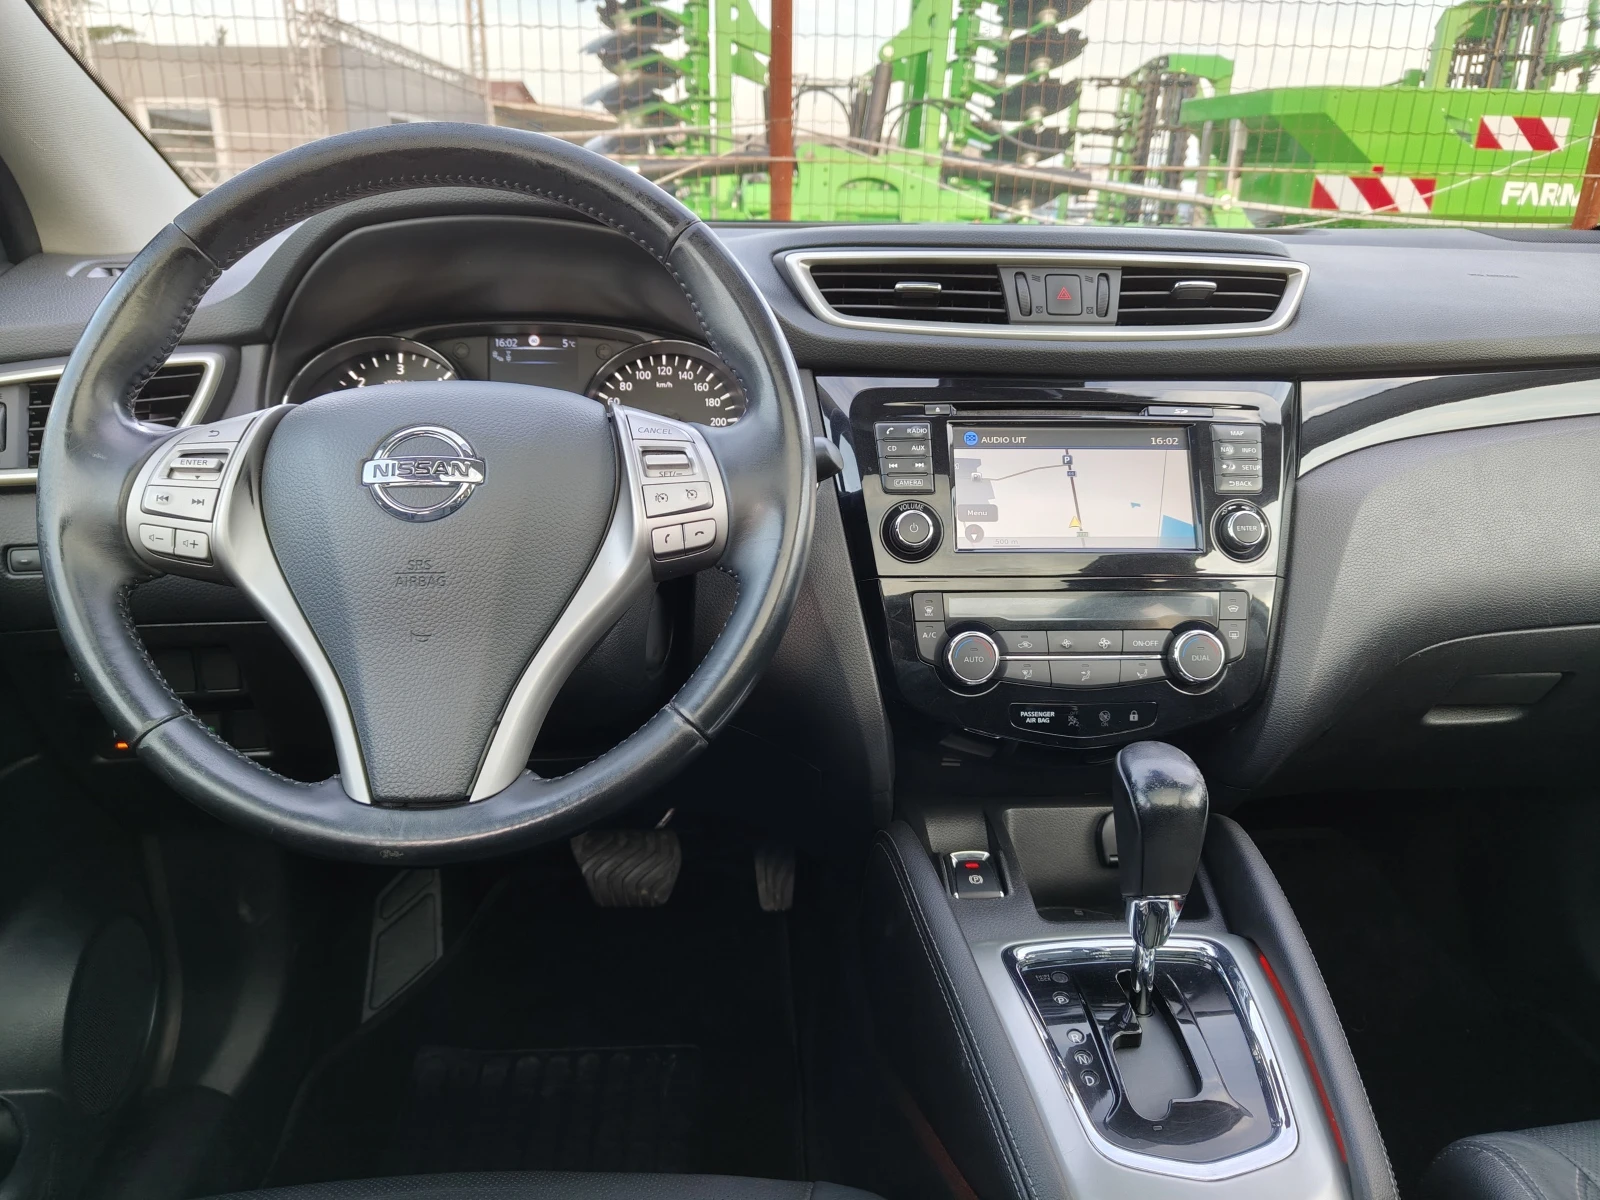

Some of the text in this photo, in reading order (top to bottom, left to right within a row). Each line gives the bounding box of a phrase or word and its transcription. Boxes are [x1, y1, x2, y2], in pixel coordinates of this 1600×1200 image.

[494, 338, 518, 347] 16:02
[396, 364, 405, 375] 3
[657, 366, 673, 376] 120
[635, 370, 652, 380] 100
[678, 371, 694, 381] 140
[358, 377, 366, 388] 2
[619, 382, 633, 391] 80
[656, 381, 673, 389] km/h
[693, 382, 709, 392] 160
[705, 397, 721, 407] 180
[710, 417, 727, 427] 200
[637, 426, 673, 435] CANCEL
[981, 436, 1027, 444] AUDIO UIT
[1150, 437, 1179, 446] 16:02
[911, 443, 925, 451] AUX
[372, 460, 471, 478] NISSAN
[894, 479, 923, 487] CAMERA
[898, 503, 925, 512] VOLUME
[967, 509, 988, 517] Menu
[1236, 525, 1258, 533] ENTER
[407, 559, 432, 570] SRS
[395, 576, 447, 588] AIRBAG
[922, 631, 937, 639] A/C
[963, 655, 984, 663] AUTO
[1191, 654, 1210, 662] DUAL
[1070, 1034, 1081, 1043] R
[1078, 1055, 1088, 1065] N
[1084, 1075, 1095, 1087] D
